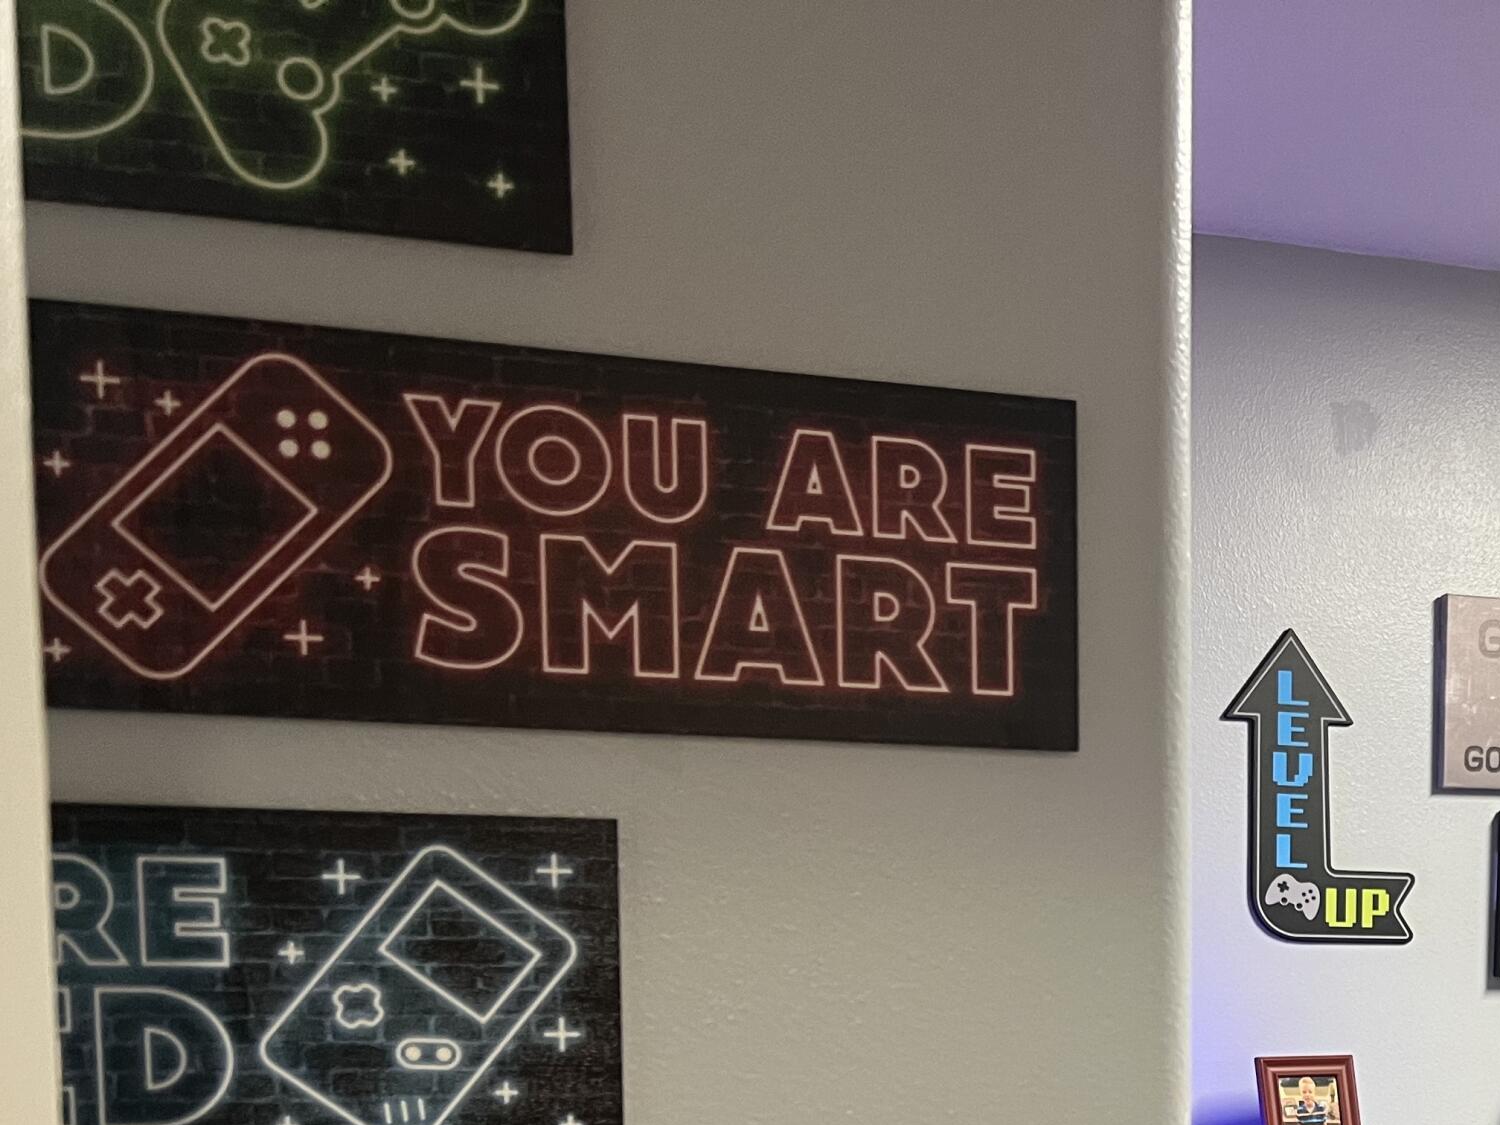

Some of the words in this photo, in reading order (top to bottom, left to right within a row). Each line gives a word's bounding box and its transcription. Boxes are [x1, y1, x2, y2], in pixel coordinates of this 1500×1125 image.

[403, 393, 707, 523] YOU
[766, 429, 1037, 549] ARE
[412, 526, 1037, 696] SMART
[1273, 670, 1313, 869] LEVEL
[1325, 887, 1390, 928] UP
